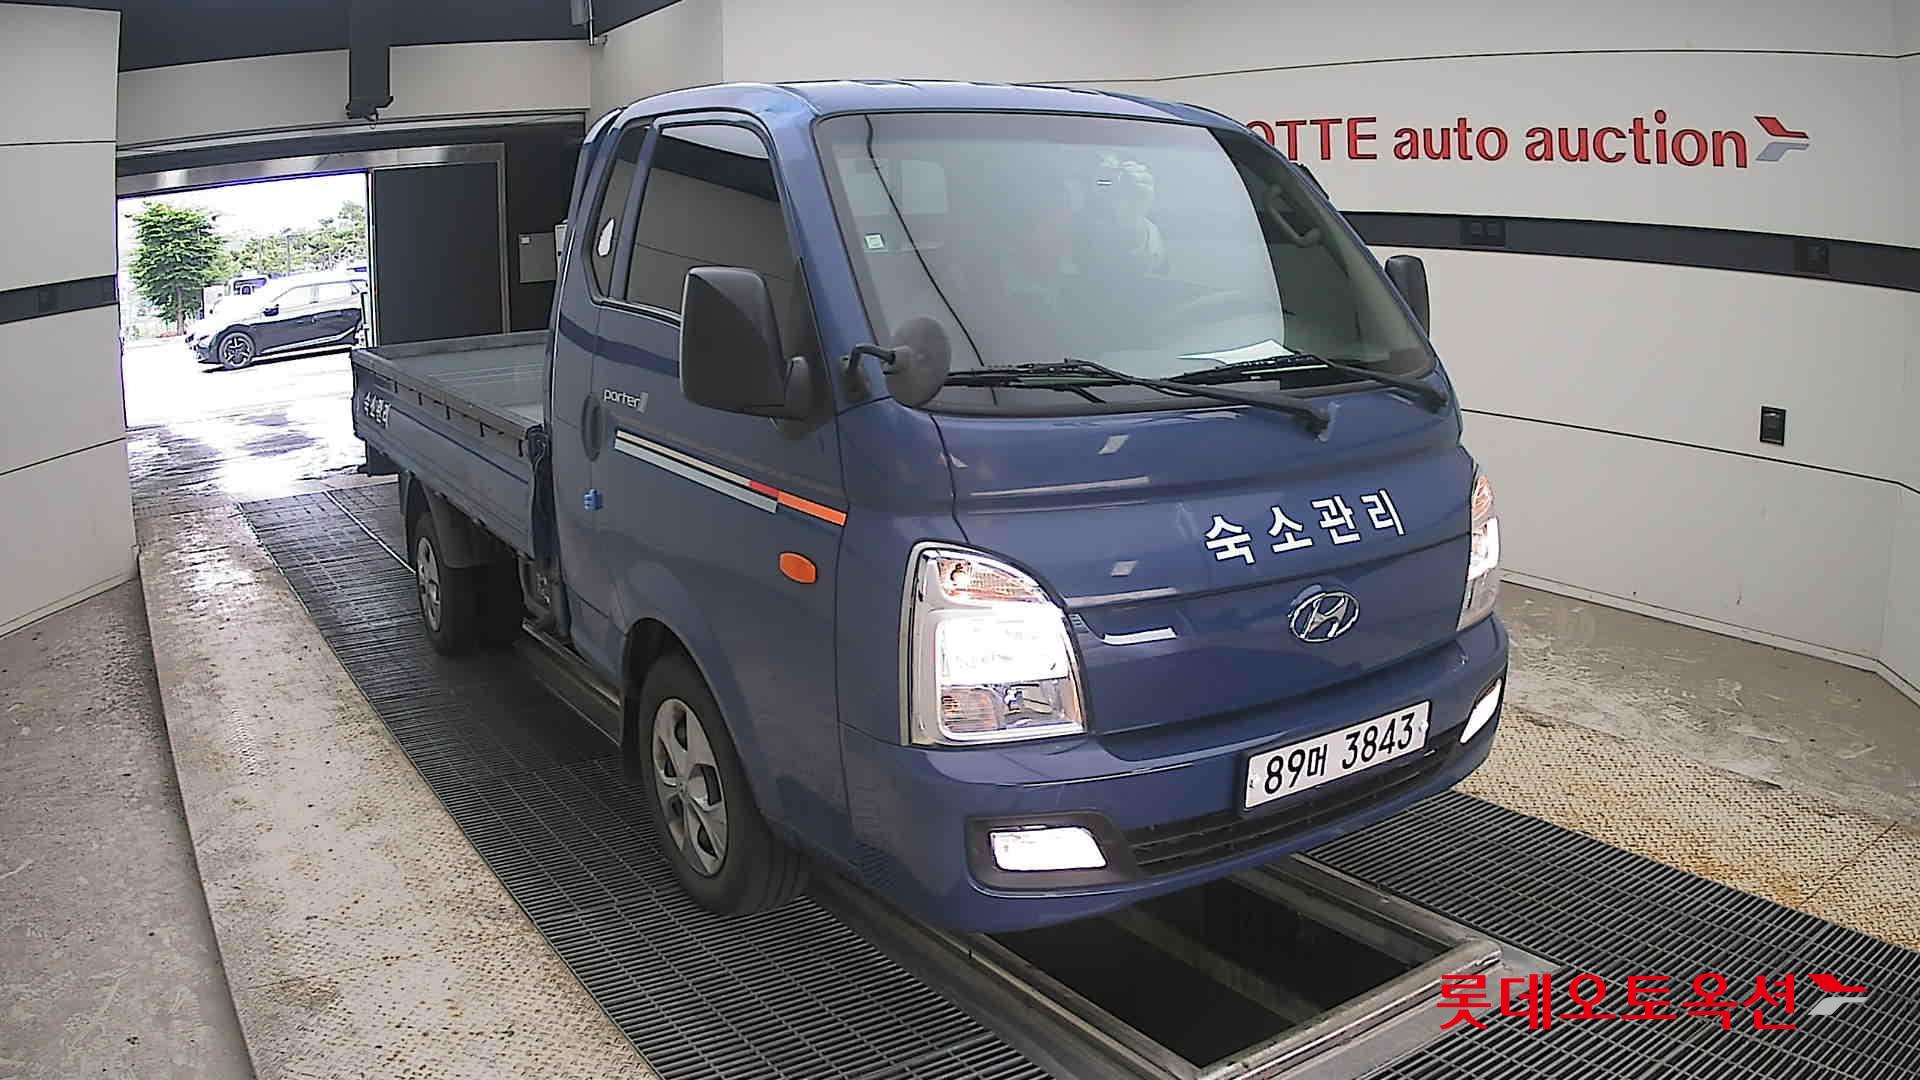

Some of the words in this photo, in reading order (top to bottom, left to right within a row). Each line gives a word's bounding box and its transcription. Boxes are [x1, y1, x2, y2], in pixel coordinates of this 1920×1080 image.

[1246, 117, 1377, 160] TTE
[1393, 117, 1508, 160] auto
[1524, 110, 1748, 168] auction
[1205, 489, 1404, 564] 숙소관리
[1264, 744, 1328, 794] 89머
[1342, 713, 1415, 769] 3843
